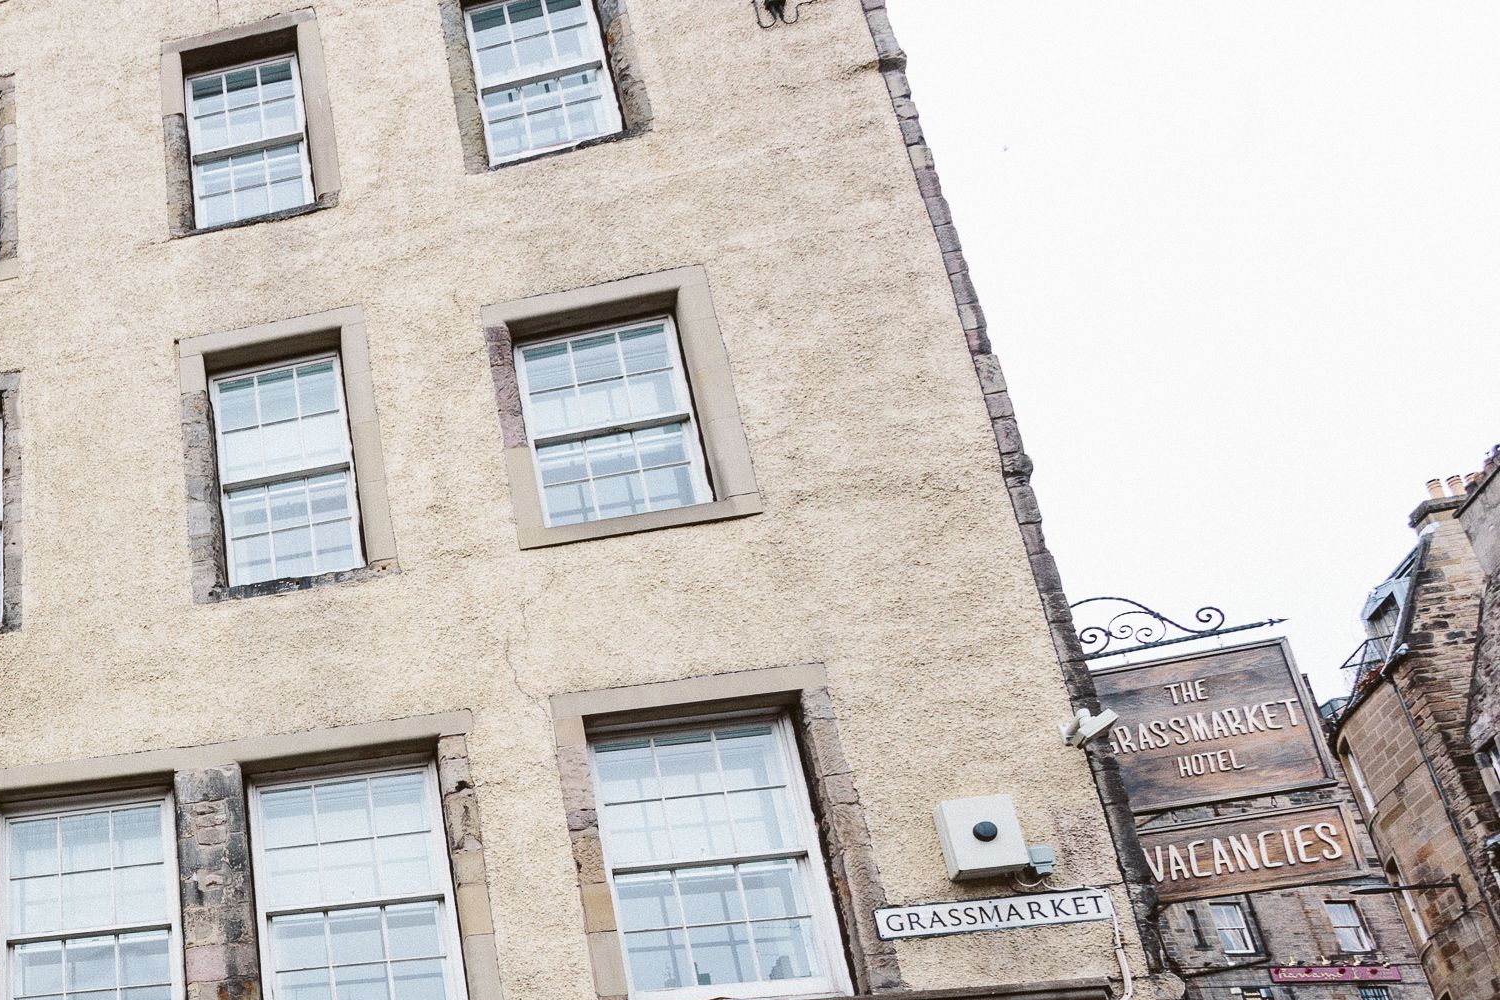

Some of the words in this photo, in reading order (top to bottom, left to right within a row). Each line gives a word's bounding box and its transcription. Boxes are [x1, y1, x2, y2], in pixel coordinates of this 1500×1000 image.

[1164, 679, 1209, 705] THE
[1178, 750, 1245, 778] HOTEL
[1142, 822, 1343, 883] VACANCIES
[886, 894, 1104, 932] GRASSMARKET
